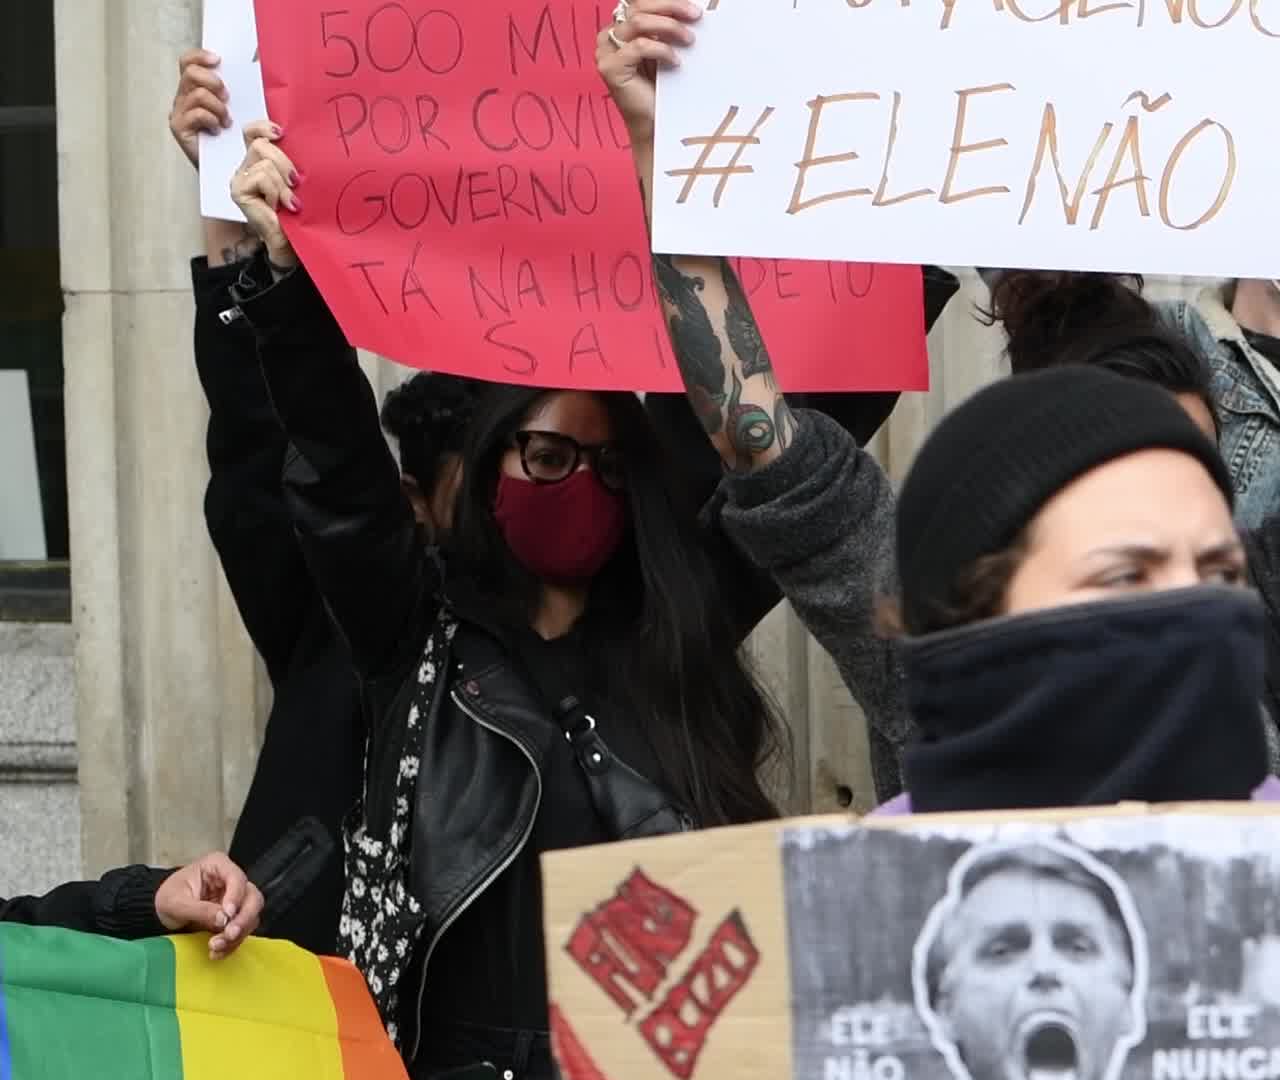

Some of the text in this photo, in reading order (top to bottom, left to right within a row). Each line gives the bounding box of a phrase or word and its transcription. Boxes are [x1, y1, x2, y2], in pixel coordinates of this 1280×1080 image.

[319, 2, 464, 78] 500
[327, 92, 451, 159] POR
[664, 81, 1237, 231] #ELENÃO
[334, 161, 599, 237] GOVERNO
[346, 241, 441, 318] TÁ
[467, 243, 545, 319] NA
[571, 249, 660, 312] HO
[1186, 1004, 1258, 1040] ELE
